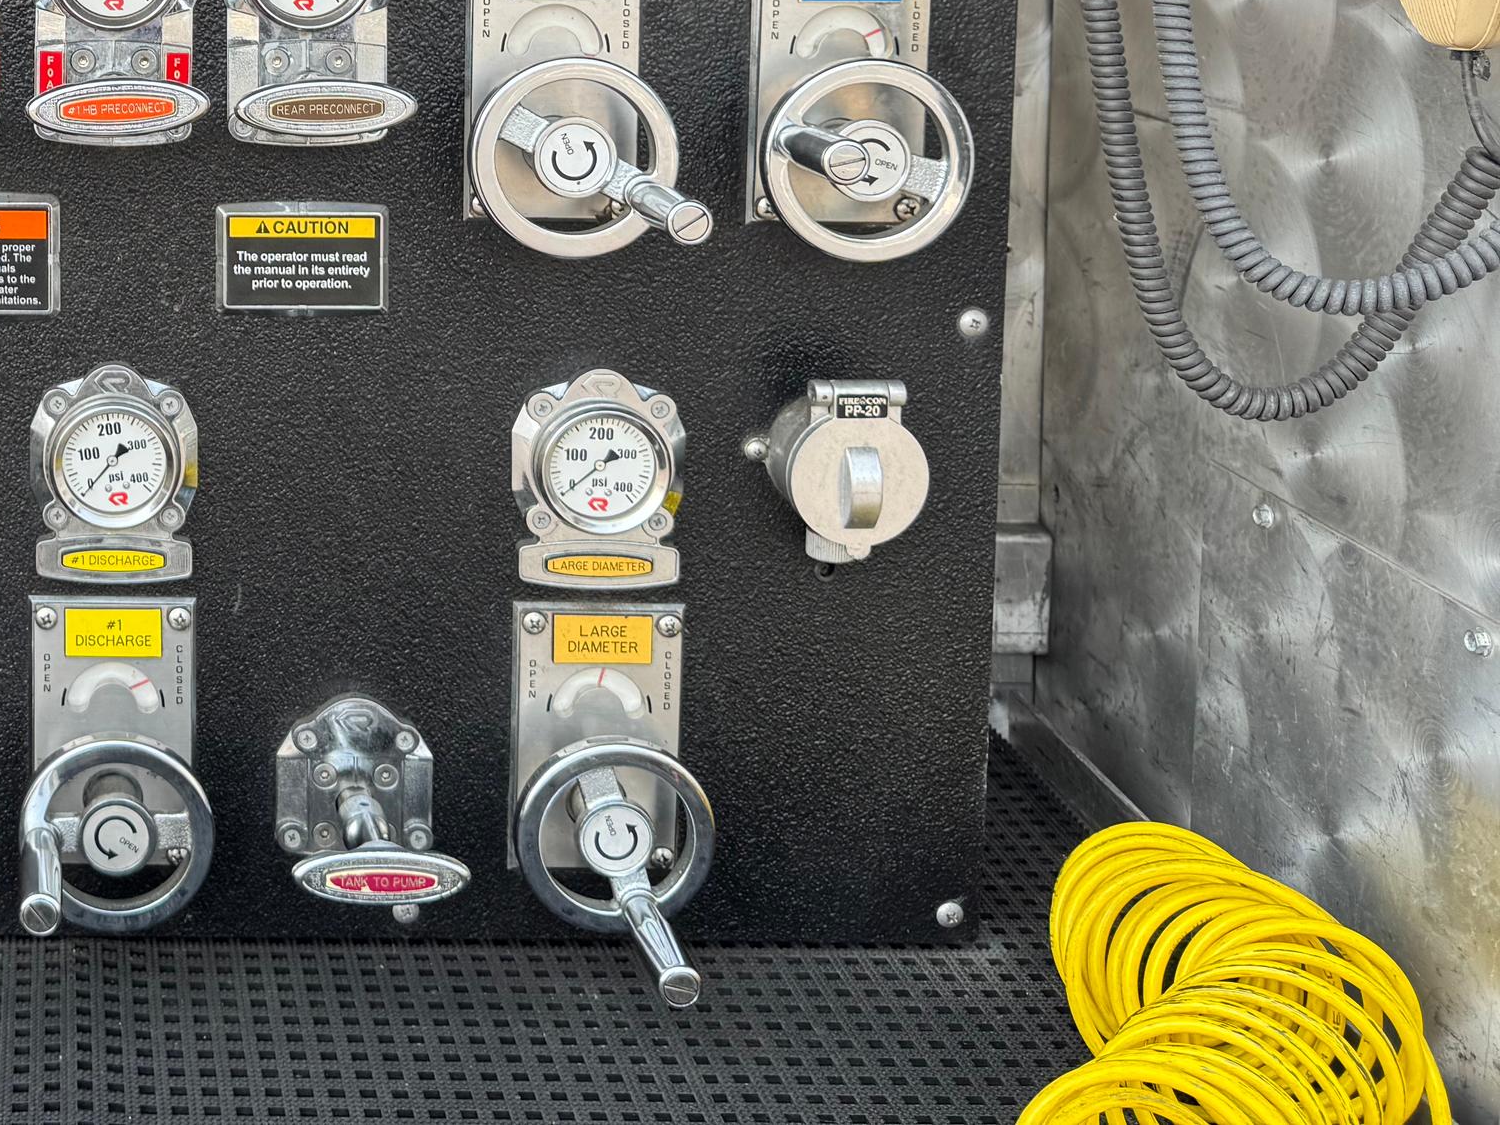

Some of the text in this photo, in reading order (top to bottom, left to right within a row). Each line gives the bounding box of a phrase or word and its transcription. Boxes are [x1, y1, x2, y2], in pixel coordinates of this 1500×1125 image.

[771, 0, 780, 40] OPEN
[83, 105, 97, 114] HB
[101, 102, 166, 114] PRECONNECT
[276, 103, 375, 115] REAR PRECONNECT
[273, 221, 348, 234] CAUTION
[2, 243, 36, 253] proper
[237, 251, 367, 263] The operator must read
[233, 265, 370, 277] the manual in its entirety
[252, 278, 352, 290] prior to operation.
[845, 406, 880, 416] PP-20
[97, 422, 121, 437] 200
[589, 427, 614, 440] 200
[72, 554, 156, 565] #1 DISCHARGE
[552, 561, 645, 571] LARGE DIAMETER
[107, 619, 122, 630] #1
[580, 625, 627, 637] LARGE
[75, 635, 151, 647] DISCHARGE
[568, 640, 638, 653] DIAMETER
[43, 653, 51, 692] OPEN
[529, 659, 537, 698] OPEN
[663, 652, 671, 710] CLOSED
[340, 877, 426, 887] TANK TO PUMP
